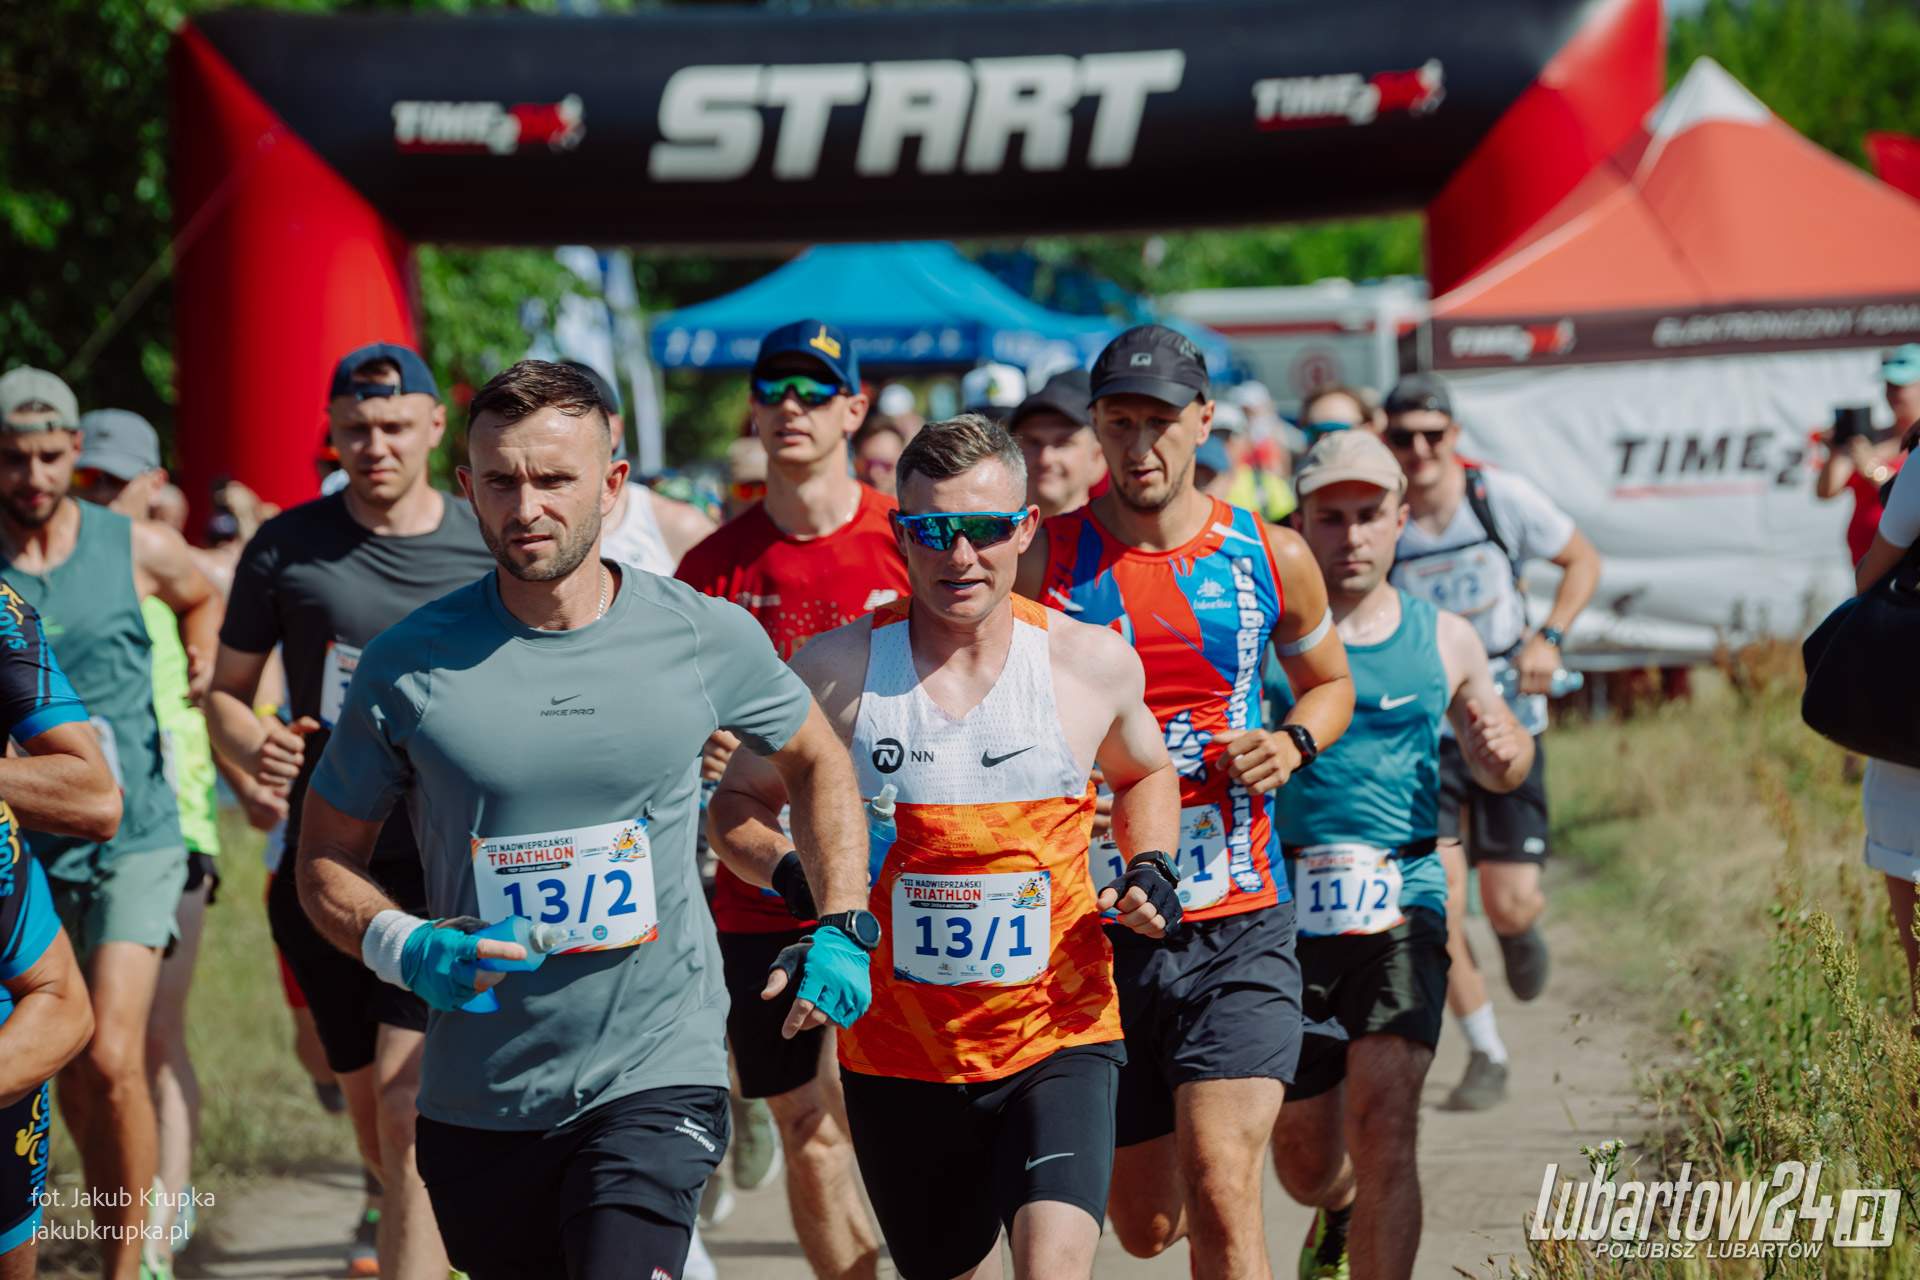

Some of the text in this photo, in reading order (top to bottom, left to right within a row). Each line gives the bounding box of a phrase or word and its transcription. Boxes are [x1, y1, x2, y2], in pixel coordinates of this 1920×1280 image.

[649, 50, 1186, 180] START
[569, 708, 595, 716] PRO
[911, 750, 934, 763] NN
[500, 836, 573, 852] NADWIEPRZAŃSKI
[488, 846, 575, 867] TRIATHLON
[915, 879, 982, 889] NADWIEPRZAŃSKI
[503, 869, 638, 924] 13/2
[904, 887, 982, 901] TRIATHLON
[1310, 879, 1389, 913] 11/2
[916, 915, 1032, 961] 13/1
